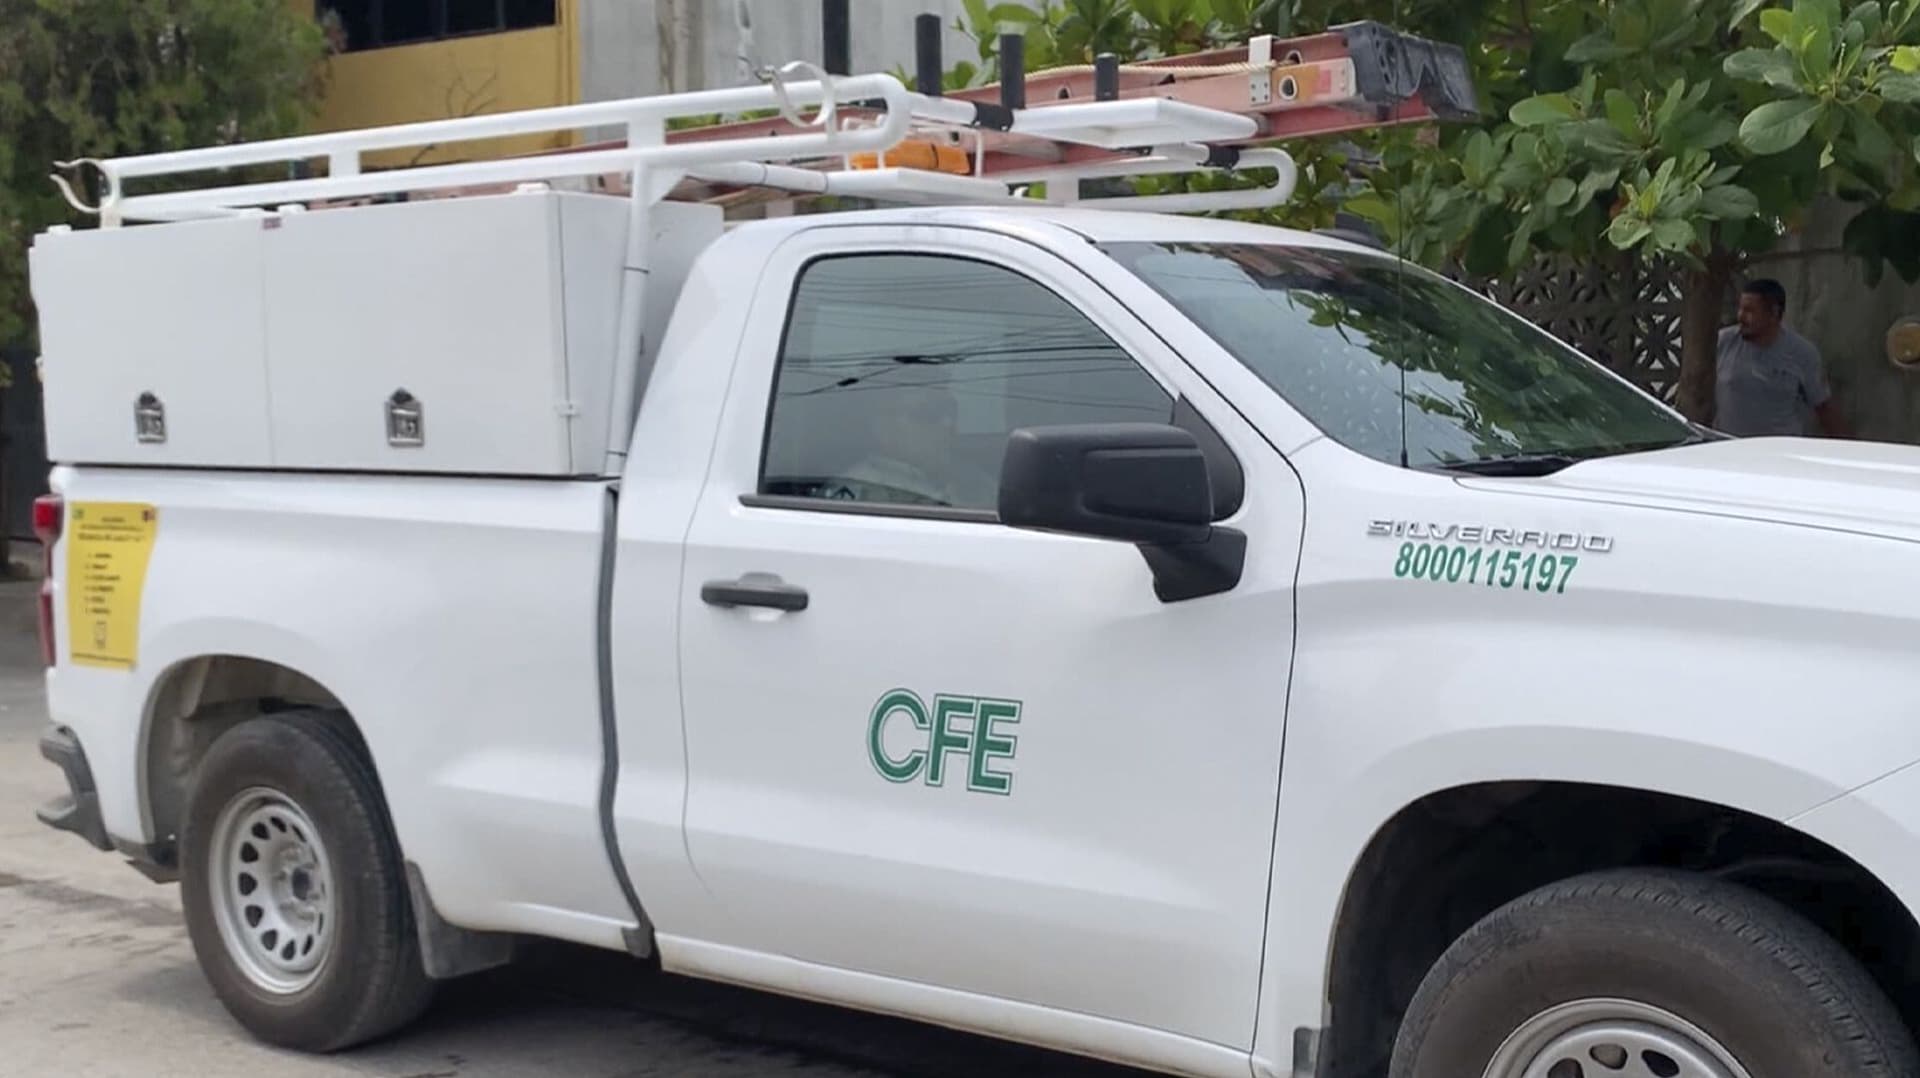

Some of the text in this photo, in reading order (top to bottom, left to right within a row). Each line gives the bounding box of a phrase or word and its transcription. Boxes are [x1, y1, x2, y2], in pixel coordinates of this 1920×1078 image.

[1367, 520, 1615, 553] SILVERADO
[1394, 542, 1578, 594] 8000115197
[866, 687, 1023, 796] CFE
